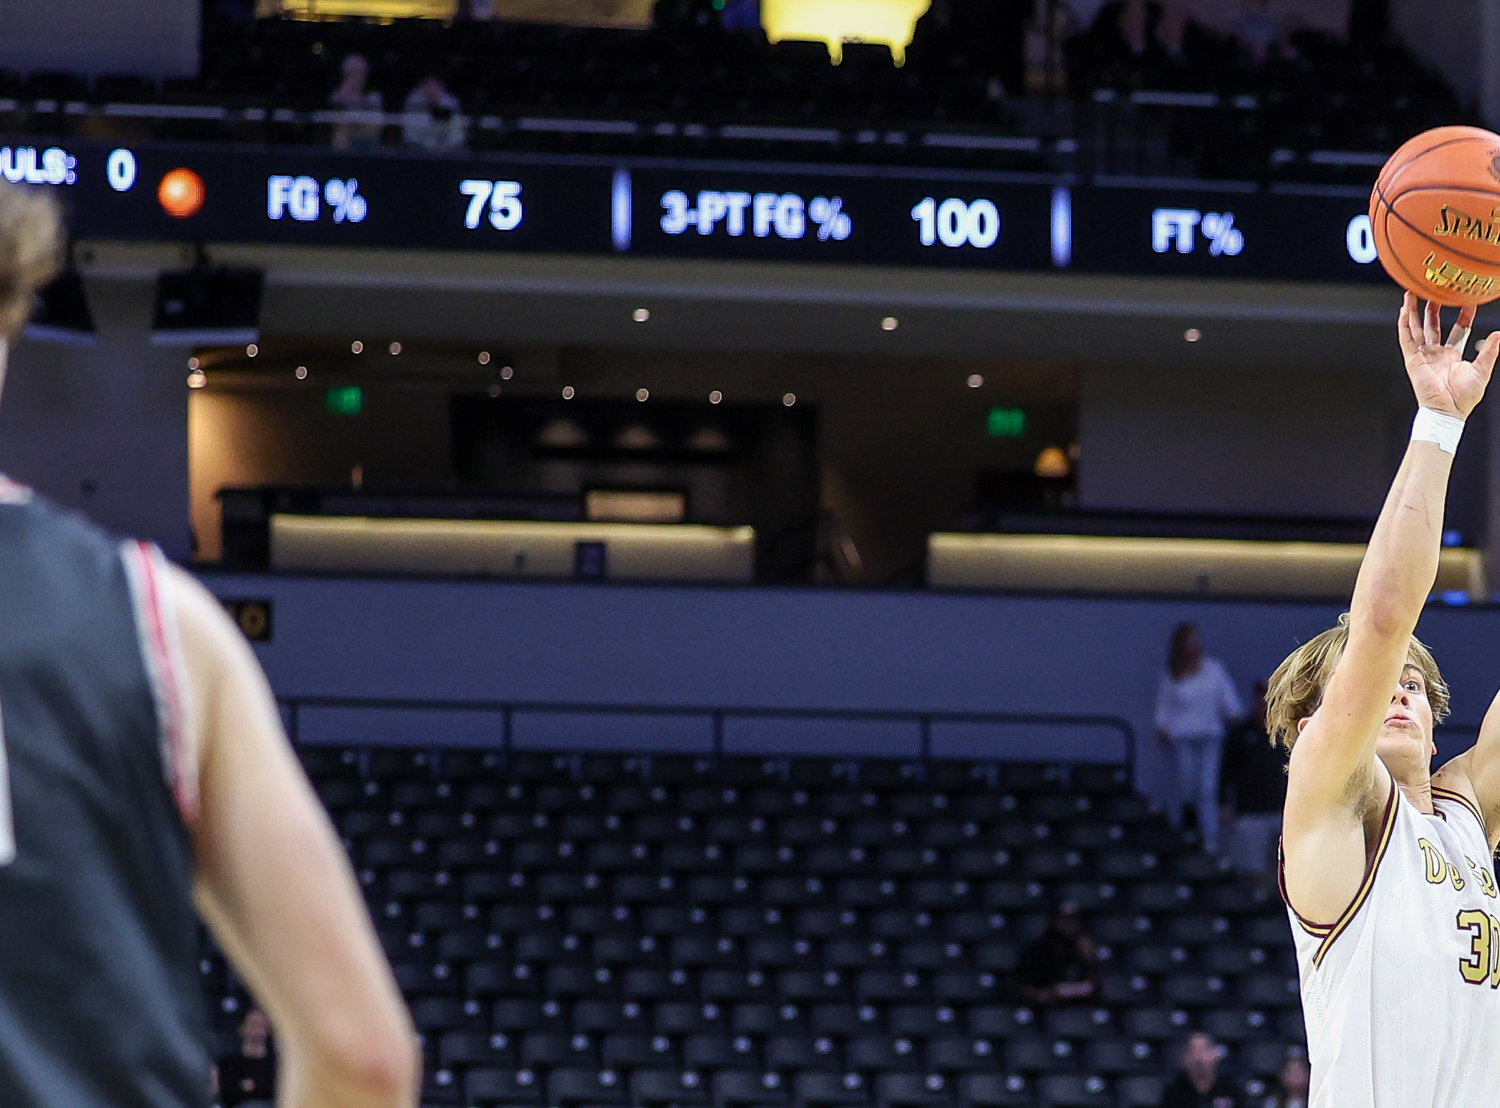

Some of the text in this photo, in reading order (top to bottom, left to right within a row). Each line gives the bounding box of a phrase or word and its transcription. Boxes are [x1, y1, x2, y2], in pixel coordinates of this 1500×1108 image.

[0, 146, 137, 192] ULS: 0
[267, 175, 523, 231] FG % 75
[660, 190, 1000, 248] 3-PT FG % 100
[1151, 207, 1201, 254] FT
[1201, 211, 1244, 257] %
